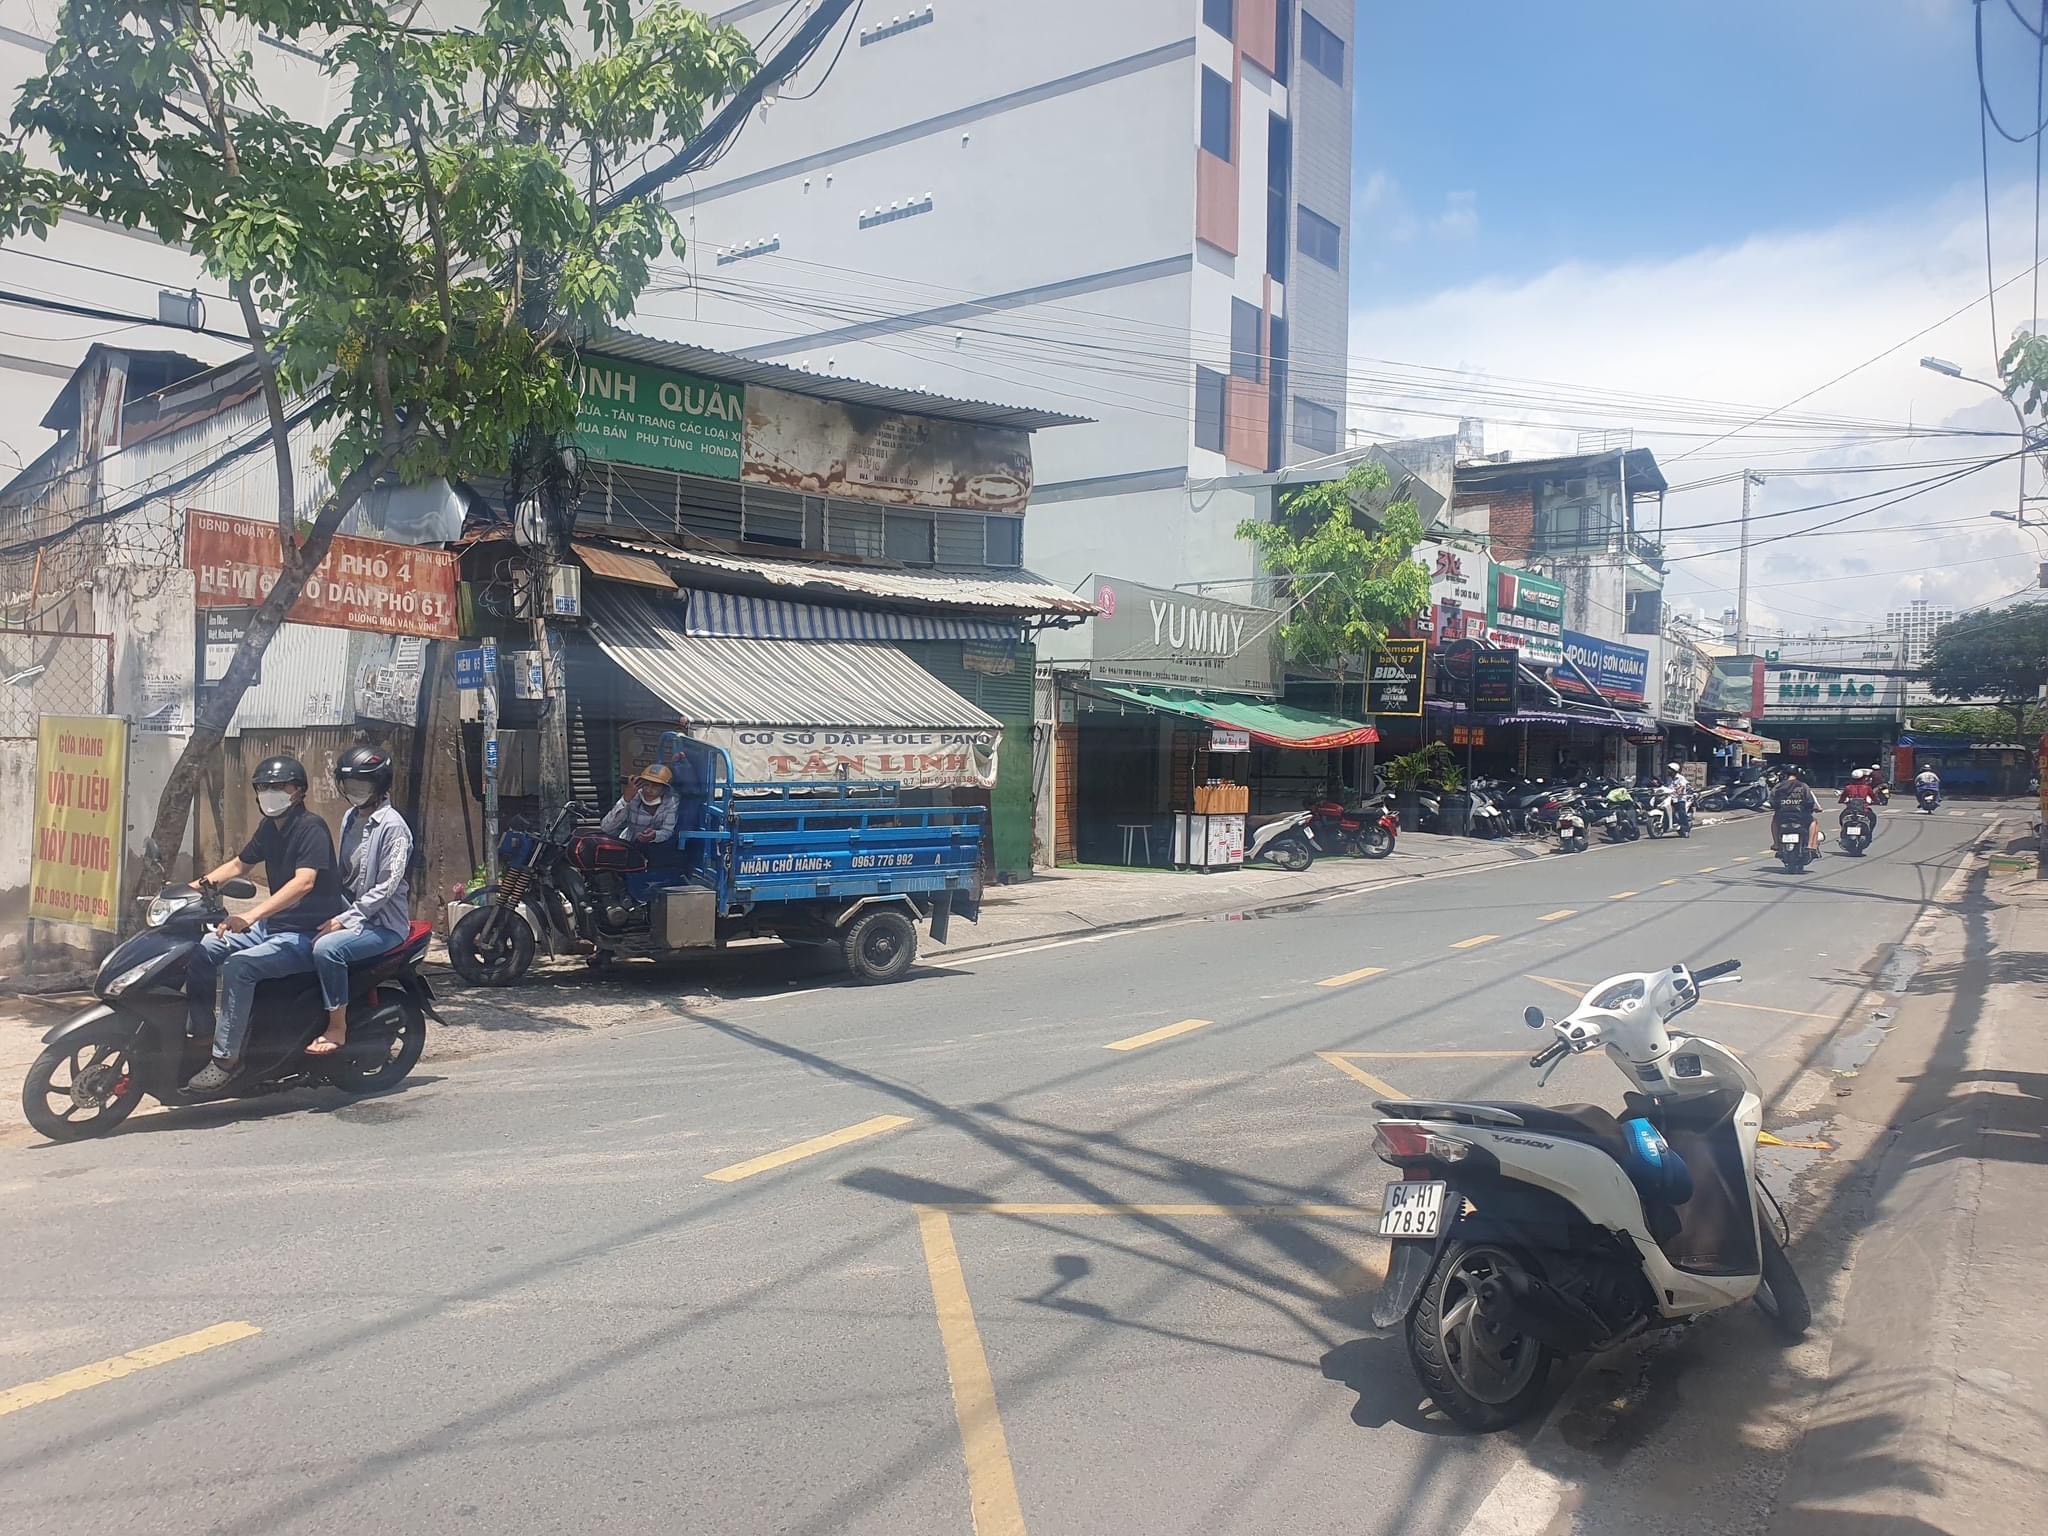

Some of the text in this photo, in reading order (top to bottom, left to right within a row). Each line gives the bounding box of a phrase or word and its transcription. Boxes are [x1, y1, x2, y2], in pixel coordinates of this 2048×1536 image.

[573, 365, 636, 403] INH
[638, 414, 676, 430] TRANG
[679, 420, 702, 434] CÁC
[705, 428, 728, 441] LOẠI
[603, 424, 627, 439] BÁN
[636, 431, 659, 448] PHỤ
[662, 434, 693, 451] TÙNG
[700, 444, 739, 459] HONDA
[198, 517, 230, 533] UBND
[267, 528, 275, 540] 7
[339, 550, 391, 578] PHỐ
[396, 564, 411, 583] 4
[200, 559, 444, 618] HẺM 6 Ổ DÂN PHỐ 61
[348, 608, 378, 625] ĐƯỜNG
[380, 617, 395, 627] MAI
[1150, 599, 1245, 656] YUMMY
[1417, 620, 1434, 632] RCB
[1401, 655, 1414, 664] 67
[1566, 644, 1600, 669] APOLLO
[1602, 653, 1618, 672] SƠN
[1374, 666, 1405, 680] BIDA
[1779, 684, 1820, 697] KIM
[79, 733, 103, 757] HÀNG
[739, 732, 774, 745] CƠ
[825, 732, 871, 748] DẬP
[878, 733, 933, 745] TOLE
[940, 733, 991, 746] PANO
[877, 754, 970, 773] LINH
[48, 766, 110, 818] VẬT LIỆU
[39, 823, 110, 875] XÂY DỰNG
[772, 855, 793, 873] CHỞ
[795, 855, 823, 872] HÀNG
[852, 855, 875, 869] 0963
[877, 854, 895, 867] 776
[896, 853, 913, 866] 992
[1491, 1134, 1556, 1150] VISION
[1383, 1211, 1437, 1234] 178.92
